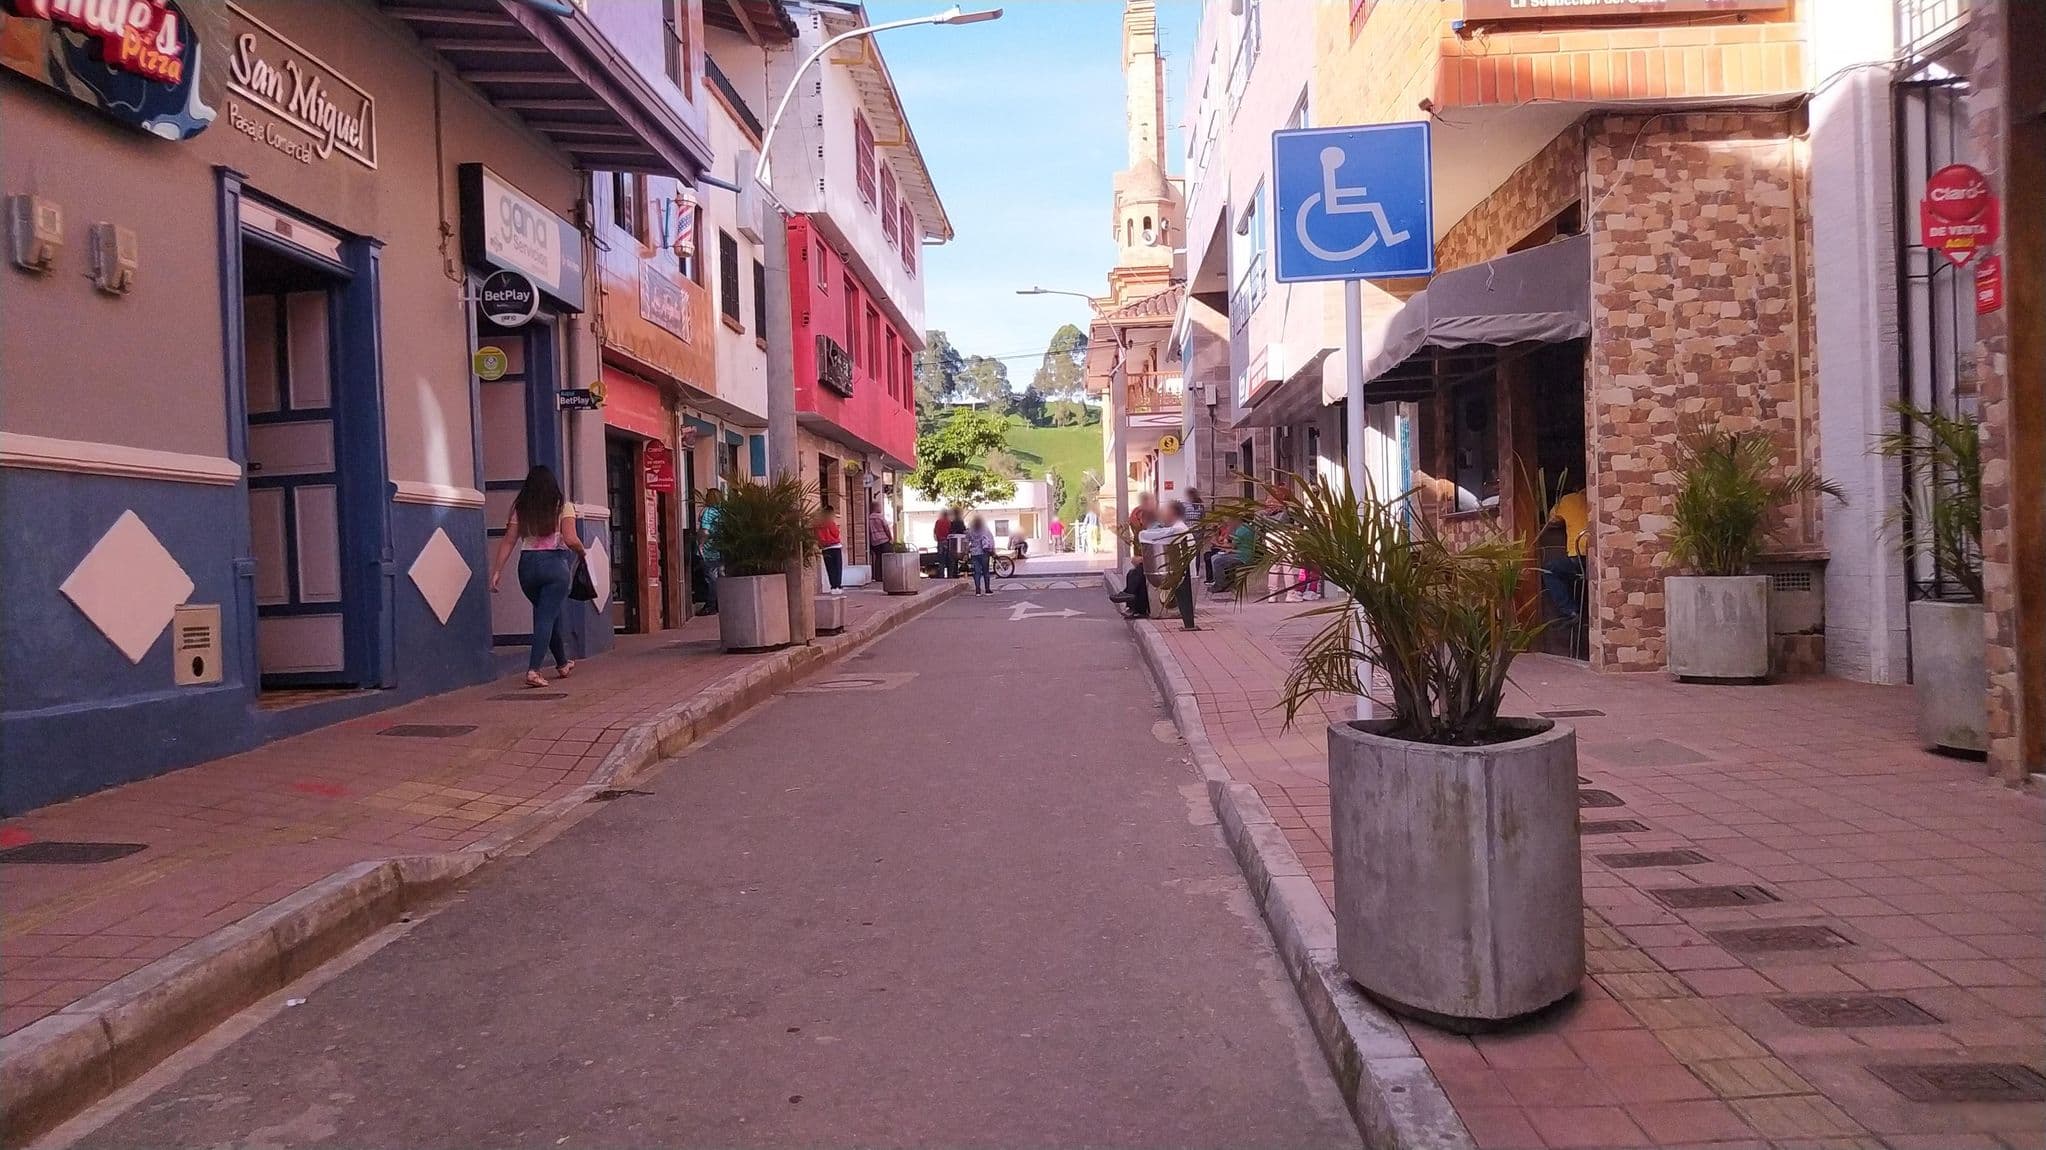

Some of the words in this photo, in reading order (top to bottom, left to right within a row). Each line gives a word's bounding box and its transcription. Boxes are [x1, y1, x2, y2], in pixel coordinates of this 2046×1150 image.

[121, 25, 184, 84] Pizza
[230, 33, 284, 104] San
[286, 60, 369, 159] Miguel
[229, 102, 265, 141] Pasaje
[266, 122, 312, 164] Comercial
[1930, 183, 1985, 202] Claro
[500, 194, 548, 250] gana
[1929, 227, 1947, 237] DE
[1948, 224, 1987, 236] VENTA
[484, 289, 531, 303] BetPlay
[560, 395, 591, 406] BetPlay
